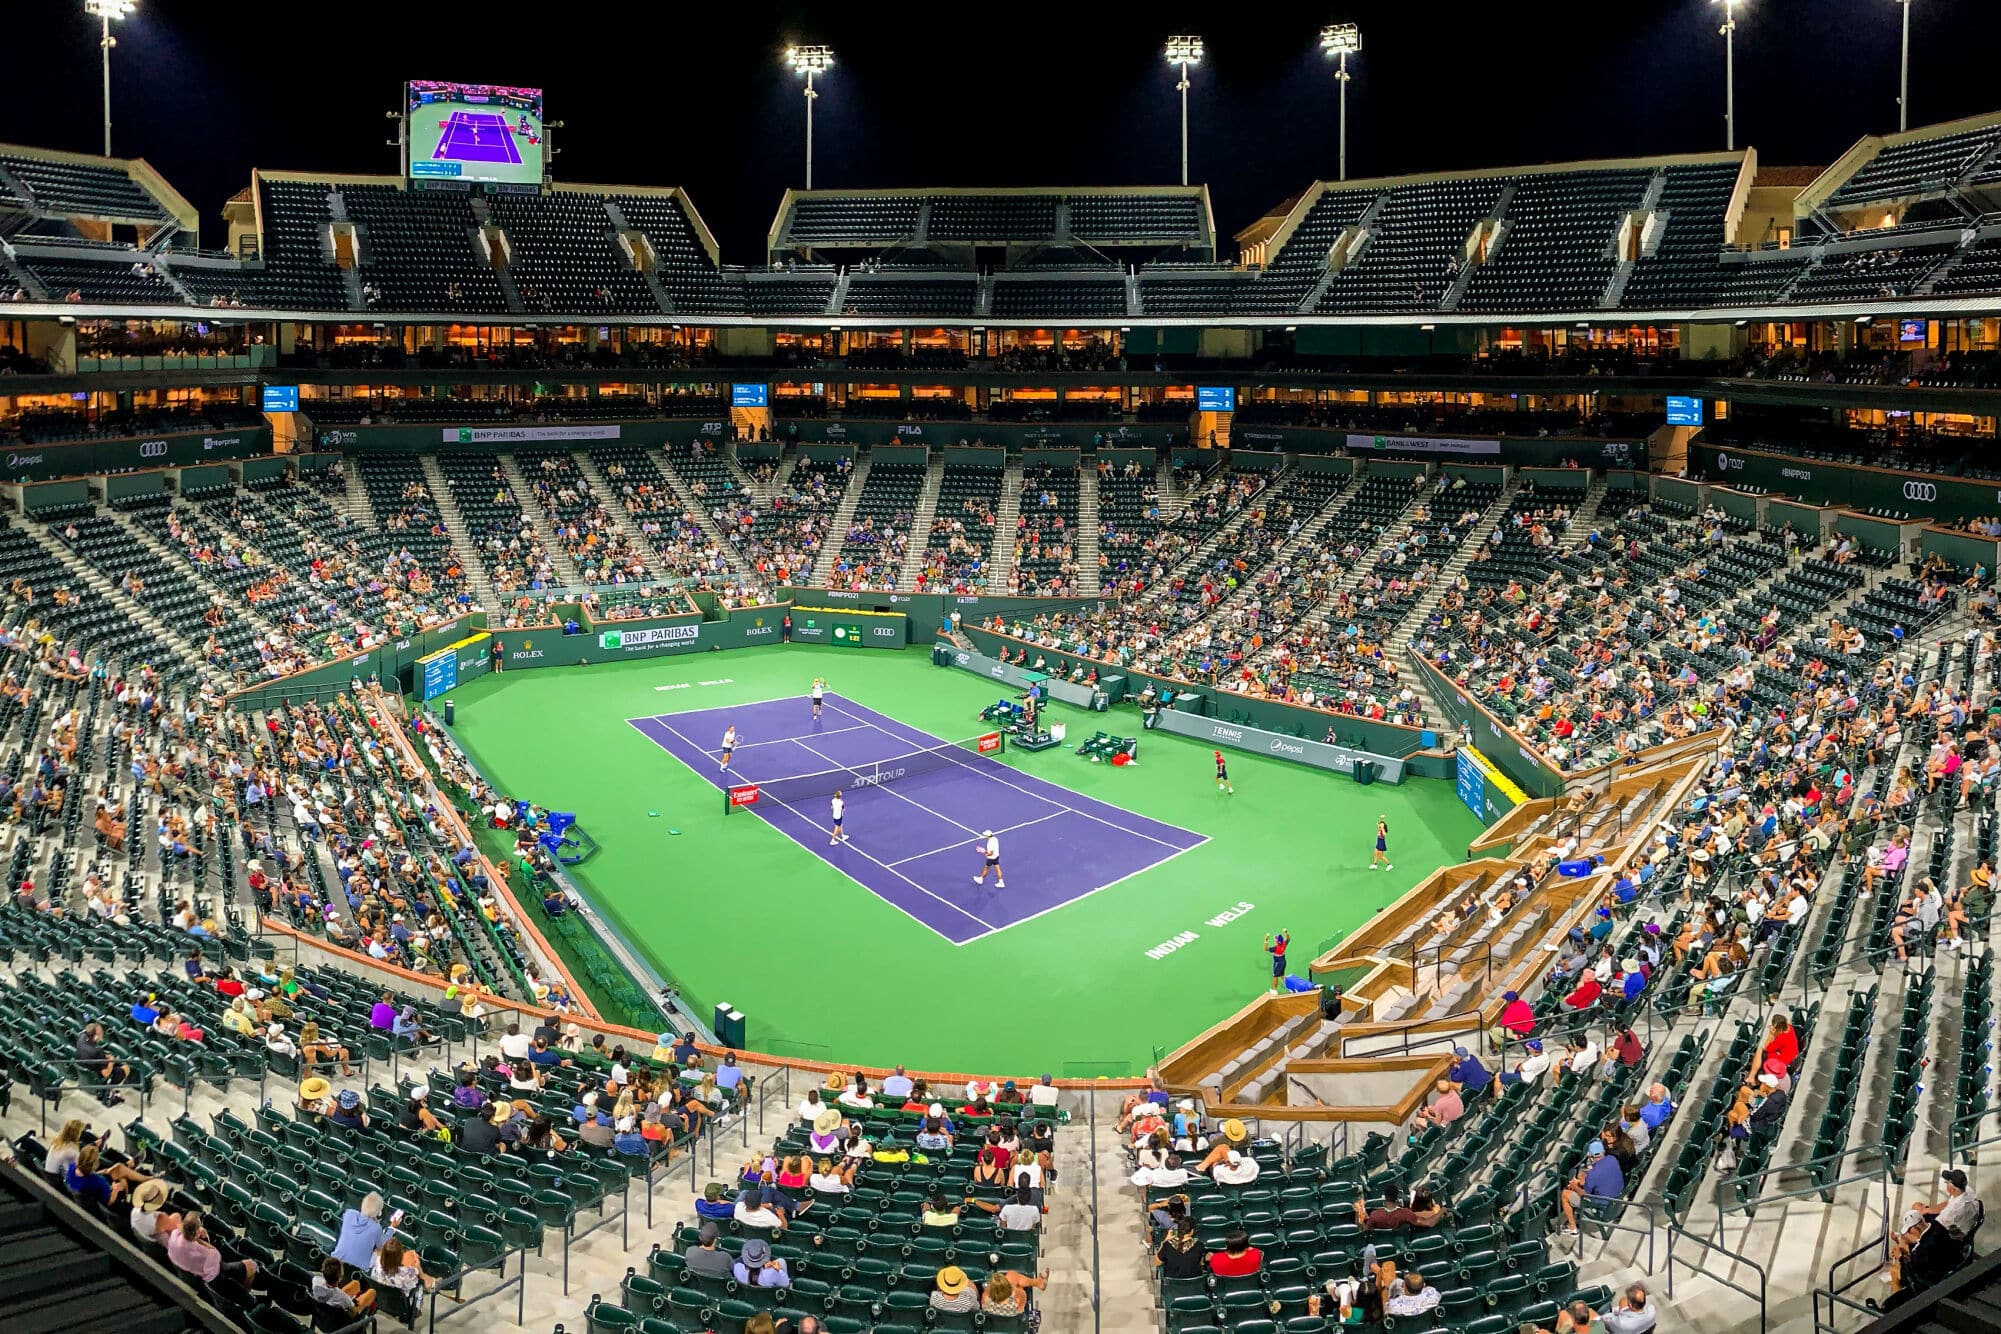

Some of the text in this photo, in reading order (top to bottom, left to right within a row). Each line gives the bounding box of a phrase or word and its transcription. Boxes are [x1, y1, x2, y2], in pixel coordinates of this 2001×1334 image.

[1693, 413, 1698, 421] 2
[474, 430, 526, 440] BNP PARIBAS
[898, 425, 922, 435] FILA
[1602, 443, 1629, 454] ATP
[1728, 458, 1745, 469] razr
[624, 626, 695, 644] BNP PARIBAS
[746, 626, 773, 636] ROLEX
[396, 639, 410, 652] FILA
[512, 649, 544, 660] ROLEX
[1213, 726, 1243, 739] TENNIS
[1490, 721, 1502, 738] FILA
[1037, 735, 1049, 743] FILA
[1281, 743, 1304, 754] pepsi
[878, 768, 906, 782] TOUR
[1144, 901, 1256, 960] INDIAN WELLS
